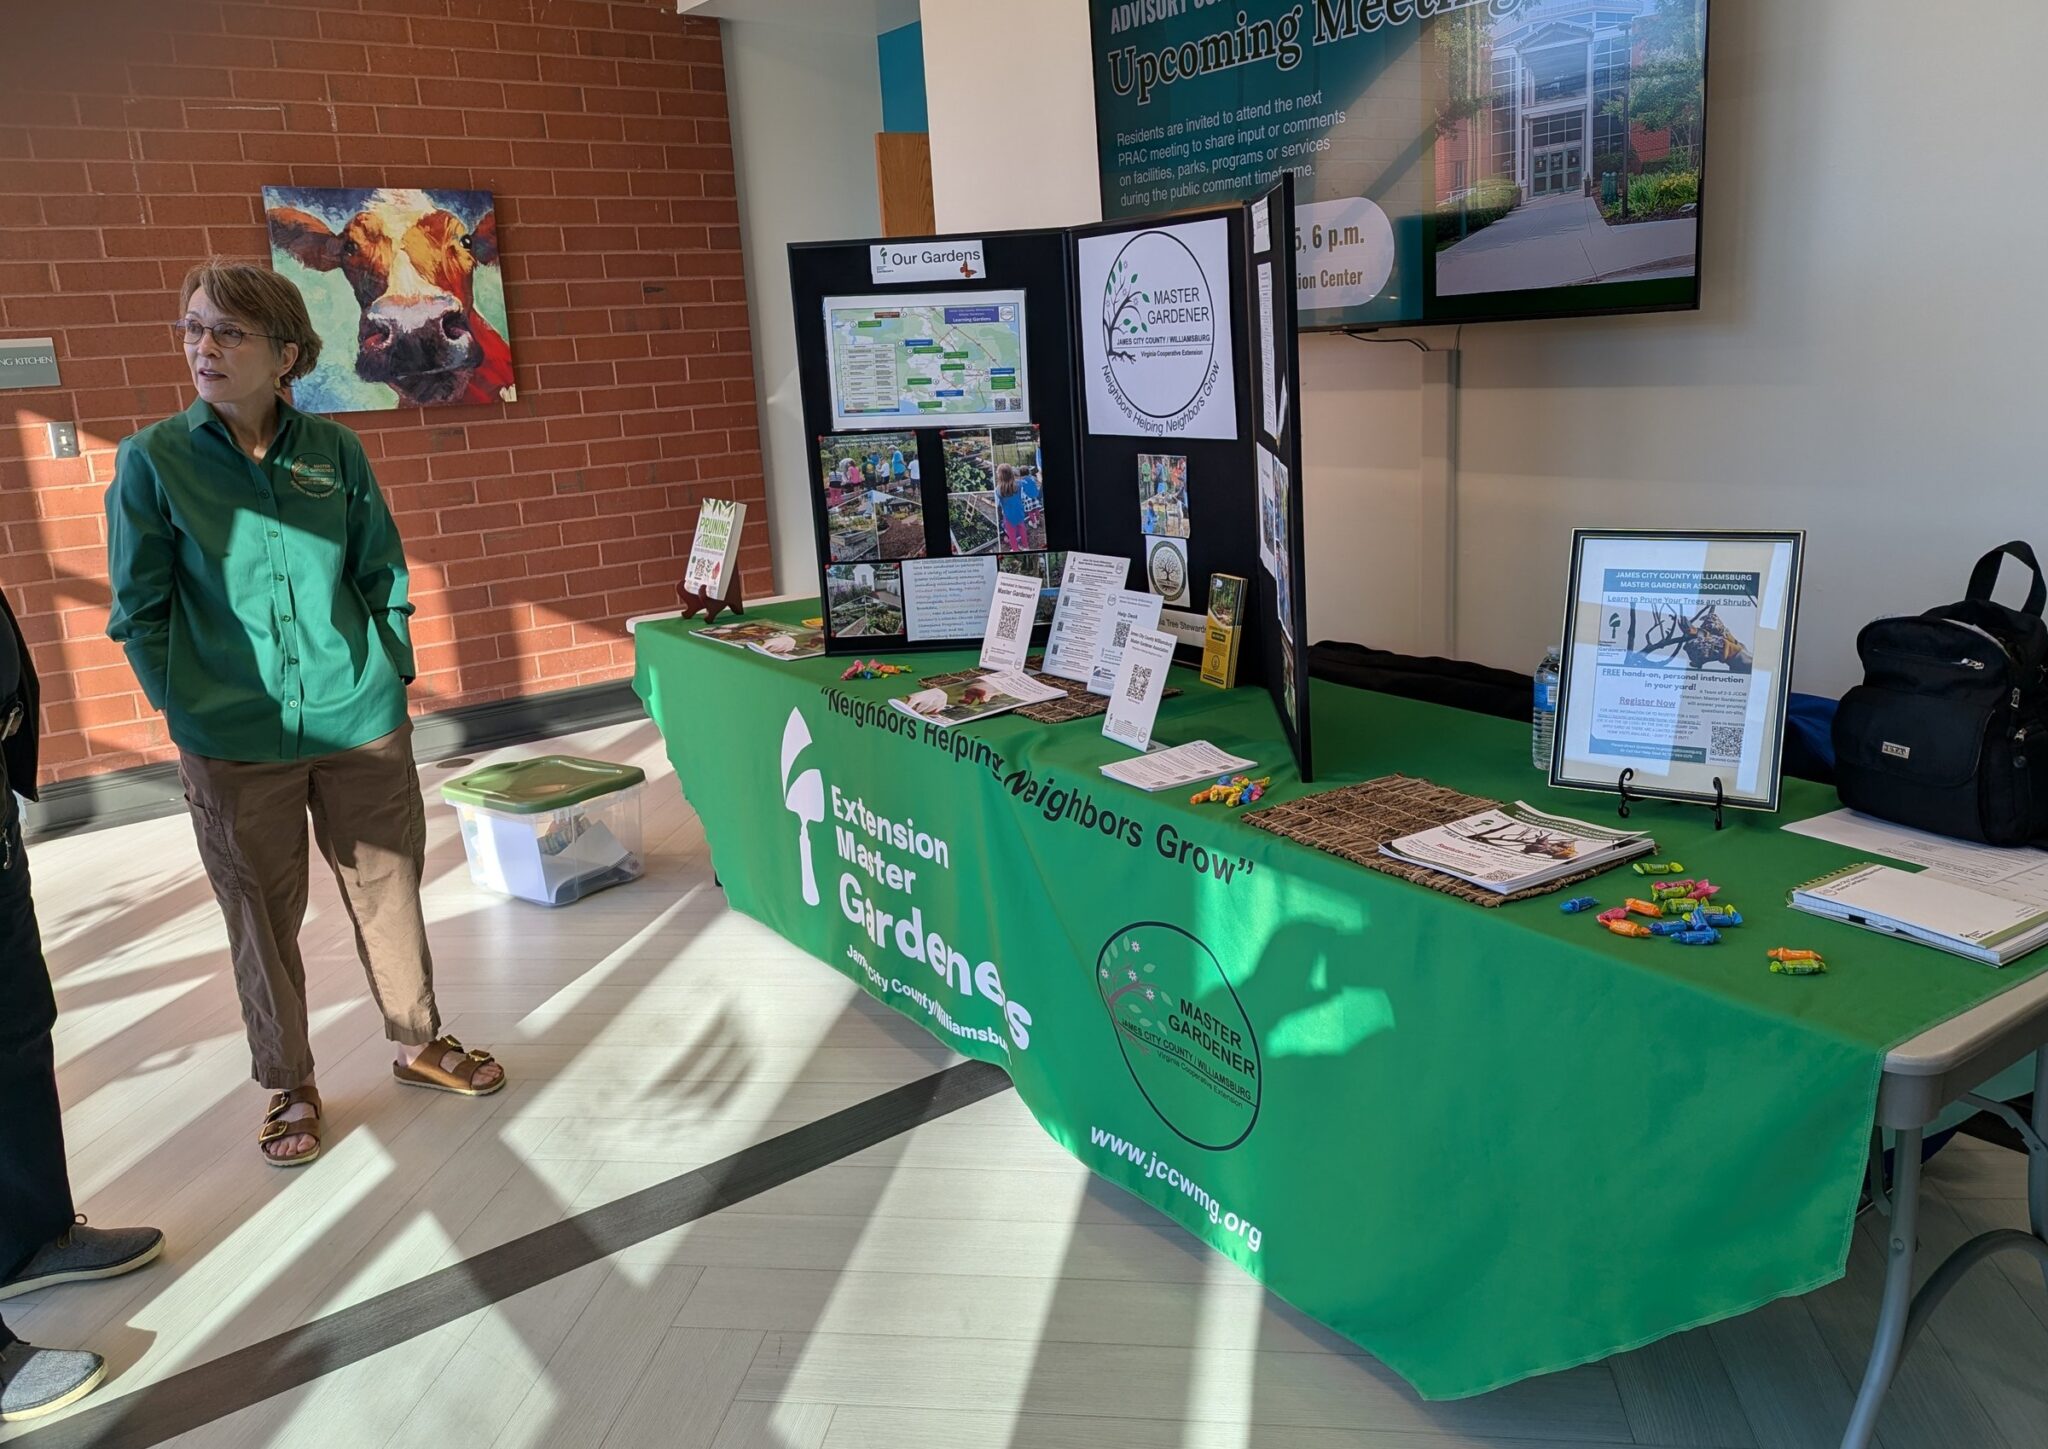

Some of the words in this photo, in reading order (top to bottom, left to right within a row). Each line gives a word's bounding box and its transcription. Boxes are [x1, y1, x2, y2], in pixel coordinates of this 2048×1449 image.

[1108, 4, 1303, 105] Upcoming
[1117, 123, 1164, 147] Residents
[1167, 122, 1184, 137] are
[1186, 112, 1219, 132] invited
[1223, 110, 1233, 124] to
[1236, 101, 1270, 122] attend
[1275, 97, 1293, 114] the
[1296, 90, 1323, 109] next
[1118, 149, 1147, 166] PRAC
[1150, 140, 1190, 161] meeting
[1192, 138, 1202, 153] to
[1205, 131, 1235, 150] share
[1238, 124, 1265, 145] input
[1268, 124, 1279, 138] or
[1283, 109, 1346, 133] comments
[1119, 175, 1131, 187] on
[1133, 166, 1175, 184] facilities,
[1178, 160, 1209, 180] parks,
[1212, 149, 1263, 172] programs
[1267, 147, 1278, 160] or
[1281, 137, 1330, 158] services
[1120, 190, 1150, 207] during
[1152, 187, 1168, 202] the
[1170, 181, 1200, 201] public
[1202, 173, 1252, 194] comment
[1312, 224, 1322, 249] 6
[1328, 225, 1364, 252] p.m.
[892, 252, 917, 266] Our
[922, 249, 980, 264] Gardens
[1320, 268, 1364, 288] Center
[1154, 287, 1200, 304] MASTER
[1147, 306, 1209, 325] GARDENER
[1117, 337, 1132, 345] JAMES
[1133, 337, 1144, 345] CITY
[1145, 336, 1166, 344] COUNTY
[1170, 334, 1210, 343] WILLIAMSBURG
[1157, 350, 1181, 358] Cooperative
[15, 356, 53, 366] KITCHEN
[1102, 364, 1133, 418] Neighbors
[1133, 411, 1163, 437] Helping
[1166, 396, 1205, 433] Neighbors
[1203, 360, 1220, 397] Grow
[1692, 573, 1752, 581] WILLIAMSBURG
[1693, 582, 1746, 590] ASSOCIATION
[1684, 598, 1704, 606] Trees
[1166, 618, 1178, 628] Tree
[1602, 668, 1620, 676] FREE
[1622, 669, 1662, 678] hands-on,
[1663, 671, 1698, 681] personal
[1700, 674, 1744, 684] instruction
[1654, 682, 1673, 690] your
[1674, 684, 1697, 692] yard!
[1619, 696, 1655, 706] Register
[1656, 698, 1676, 708] Now
[923, 722, 1005, 782] Helping
[1003, 769, 1144, 848] Neighbors
[831, 784, 949, 869] Extension
[835, 825, 917, 895] Master
[839, 872, 1032, 1050] Gardenes
[846, 944, 868, 970] Jam
[867, 965, 889, 993] City
[1180, 998, 1242, 1051] MASTER
[1121, 1018, 1143, 1037] JAMES
[1144, 1031, 1162, 1046] CITY
[1163, 1039, 1194, 1061] COUNTY
[1198, 1059, 1252, 1101] WILLIAMSBURG
[1168, 1014, 1256, 1080] GARDENER
[1156, 1050, 1180, 1067] Virginia
[1181, 1062, 1213, 1090] Cooperative
[1213, 1086, 1243, 1108] Extension
[1091, 1126, 1262, 1252] www.jccwmg.org
